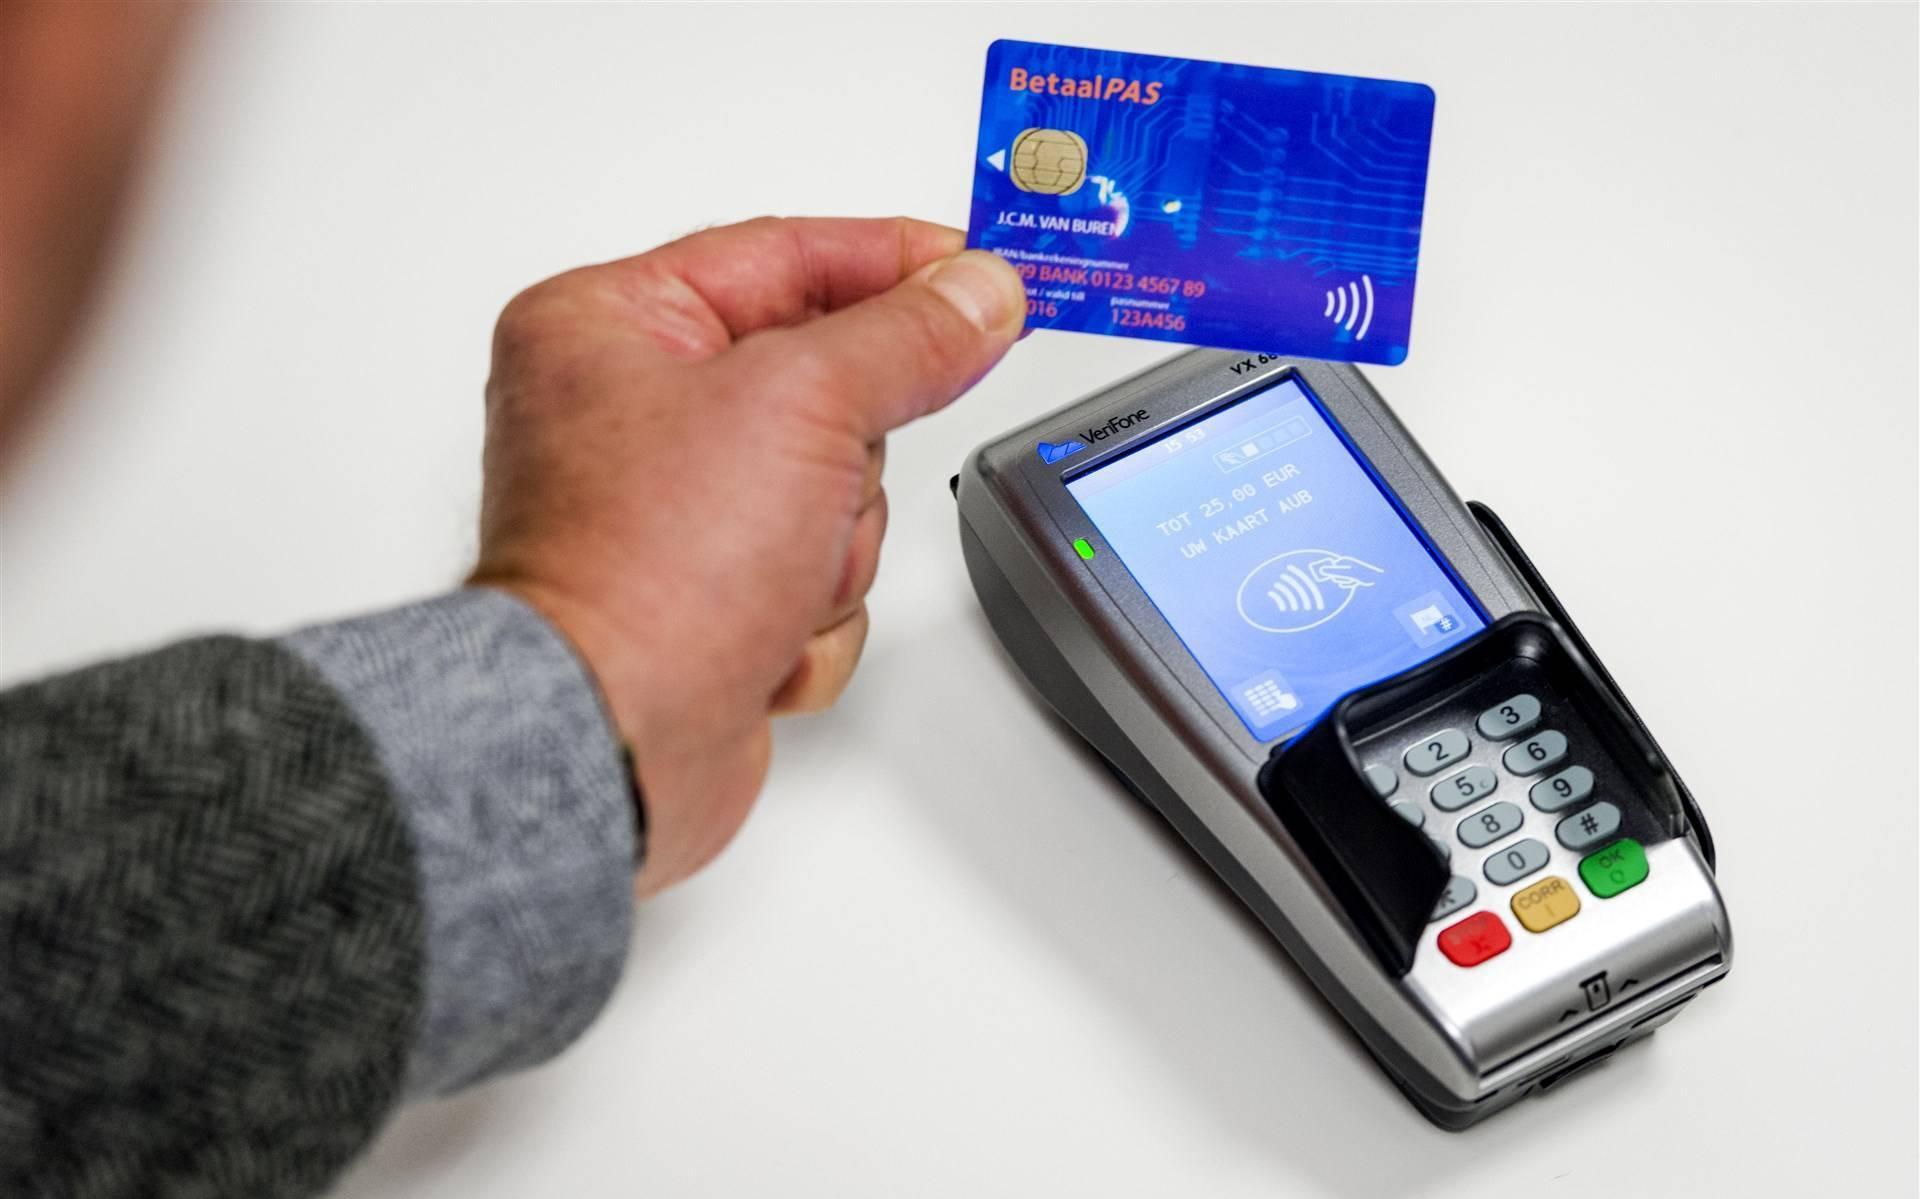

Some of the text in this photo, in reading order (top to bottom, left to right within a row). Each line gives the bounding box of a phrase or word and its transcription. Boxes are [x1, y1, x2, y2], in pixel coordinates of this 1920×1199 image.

[997, 211, 1119, 236] J.C.M. VAN BUREN
[1039, 264, 1088, 285] BANK
[1091, 269, 1133, 290] 0123
[1137, 274, 1180, 295] 4567
[1182, 280, 1205, 297] 89
[1026, 299, 1058, 317] 016
[1110, 298, 1170, 310] pasnummer
[1111, 308, 1186, 331] 123A456
[1230, 359, 1257, 375] VX
[1079, 409, 1151, 444] VeriFone
[1156, 463, 1301, 536] TOT 25,00 EUR
[1180, 489, 1313, 559] UW KAART AUB
[1500, 705, 1521, 726] 3
[1428, 741, 1450, 761] 2
[1527, 742, 1548, 762] 6
[1455, 775, 1475, 797] 5
[1553, 778, 1573, 800] 9
[1480, 814, 1501, 834] 8
[1580, 813, 1600, 834] #
[1506, 850, 1527, 871] 0
[1599, 849, 1625, 869] OK
[1517, 878, 1566, 910] CORR
